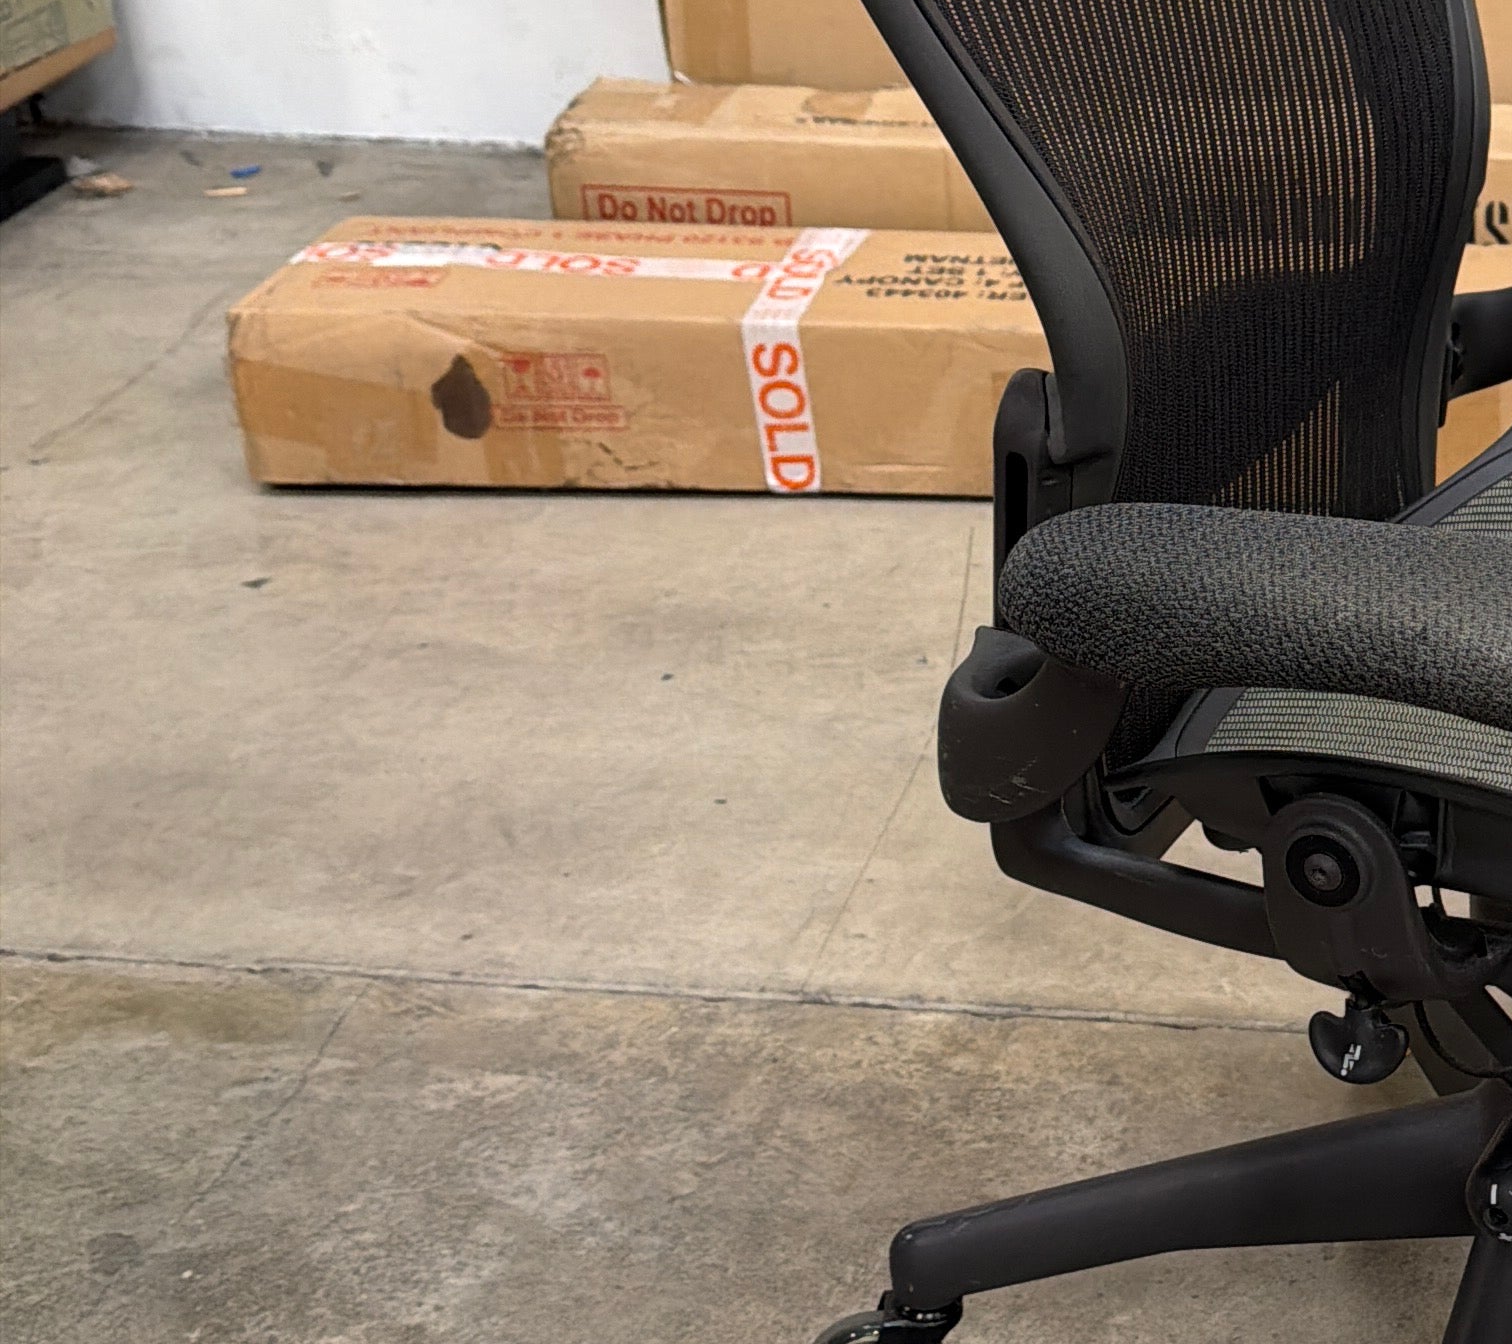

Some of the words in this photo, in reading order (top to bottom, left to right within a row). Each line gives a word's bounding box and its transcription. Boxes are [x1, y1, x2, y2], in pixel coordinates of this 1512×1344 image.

[597, 193, 638, 221] Do
[647, 196, 698, 224] Not
[706, 198, 777, 227] Drop
[752, 342, 816, 491] SOLD
